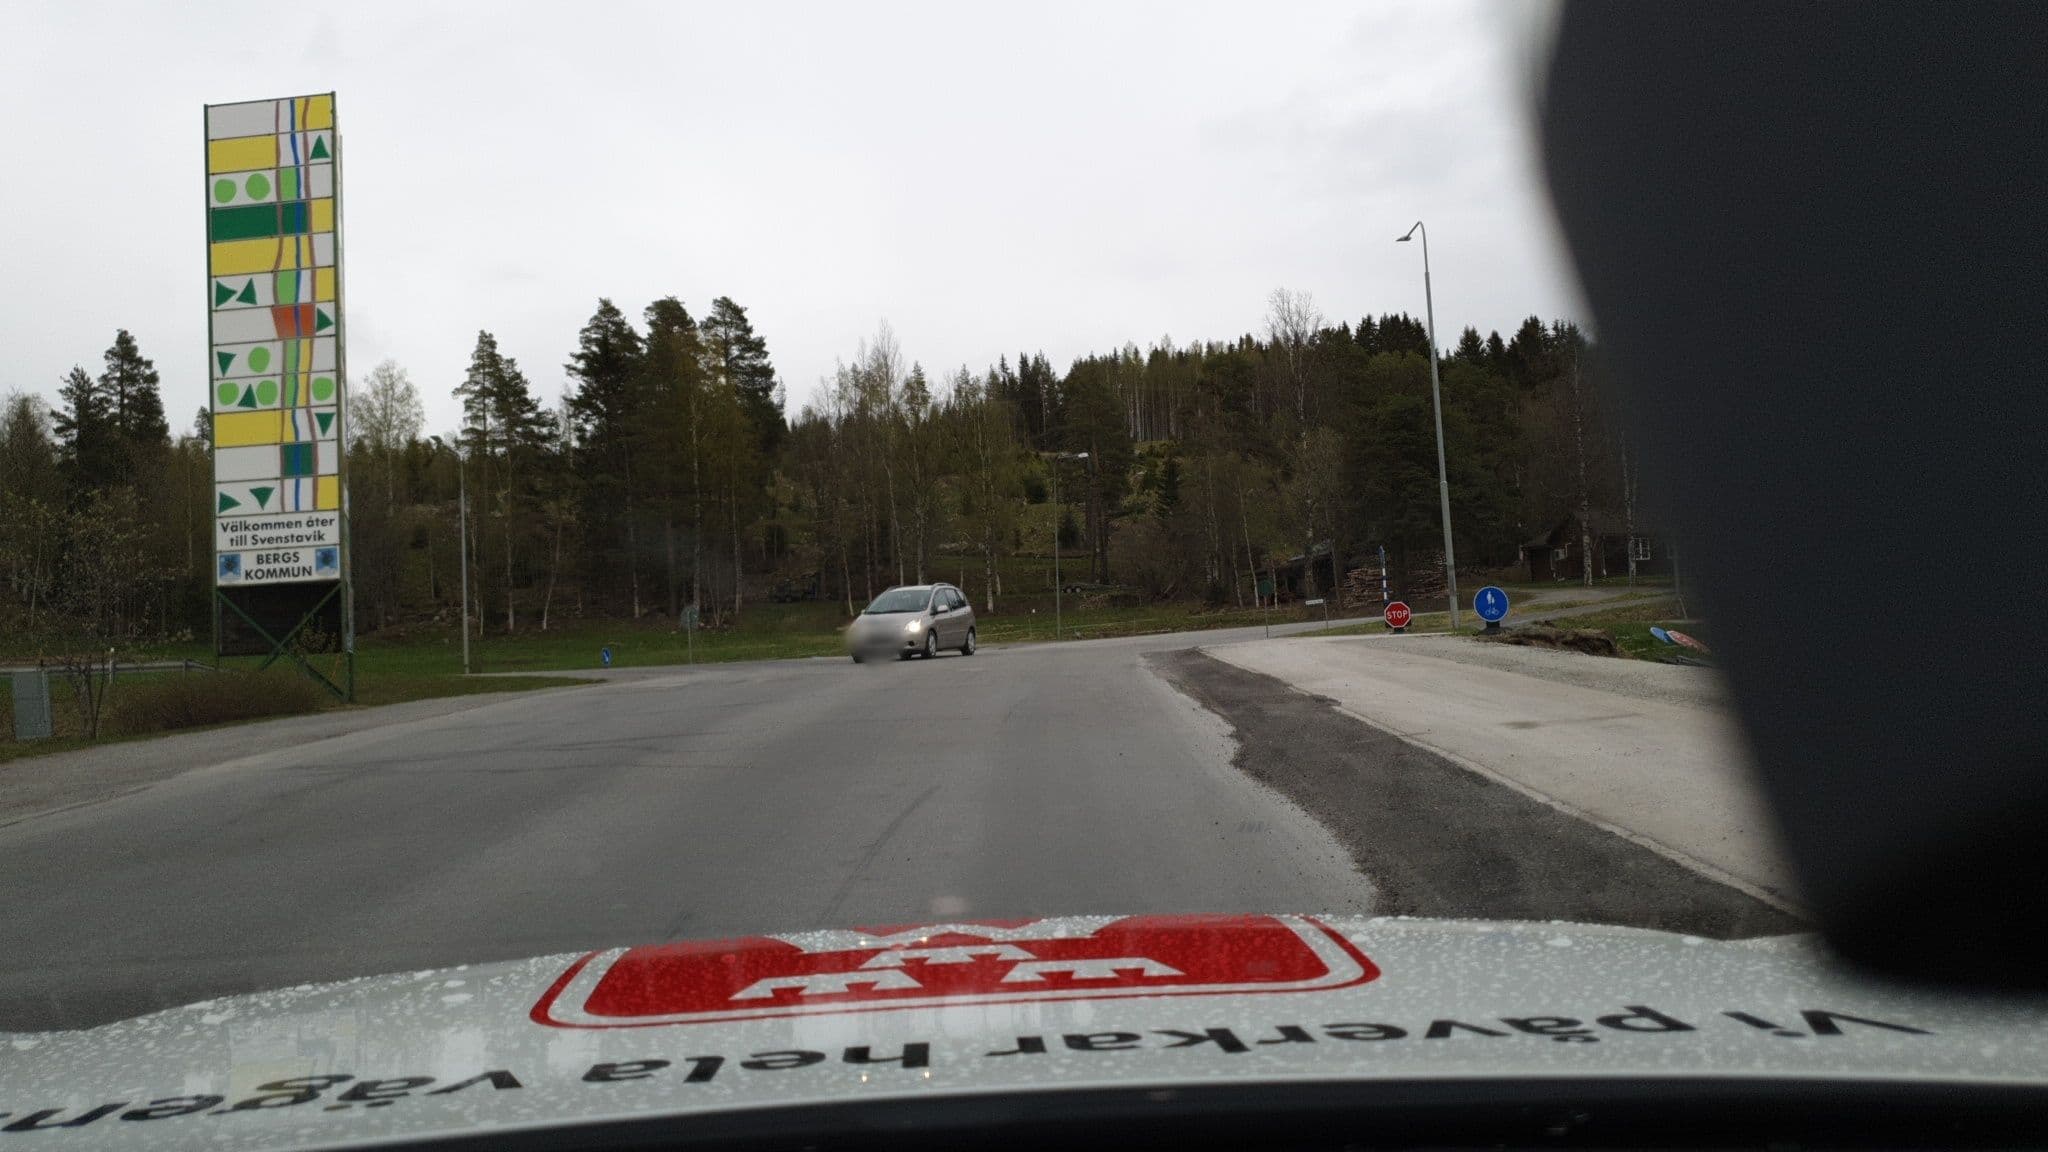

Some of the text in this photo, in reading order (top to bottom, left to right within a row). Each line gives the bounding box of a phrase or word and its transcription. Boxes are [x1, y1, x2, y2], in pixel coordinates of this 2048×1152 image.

[220, 516, 335, 533] Välkommen åter
[230, 530, 325, 546] till Svenstavik
[256, 551, 300, 565] BERGS
[245, 566, 312, 580] KOMMUN
[1386, 610, 1408, 620] STOP
[984, 1005, 1698, 1056] påverkar
[1720, 1009, 1935, 1038] Vi
[581, 1042, 930, 1083] hela
